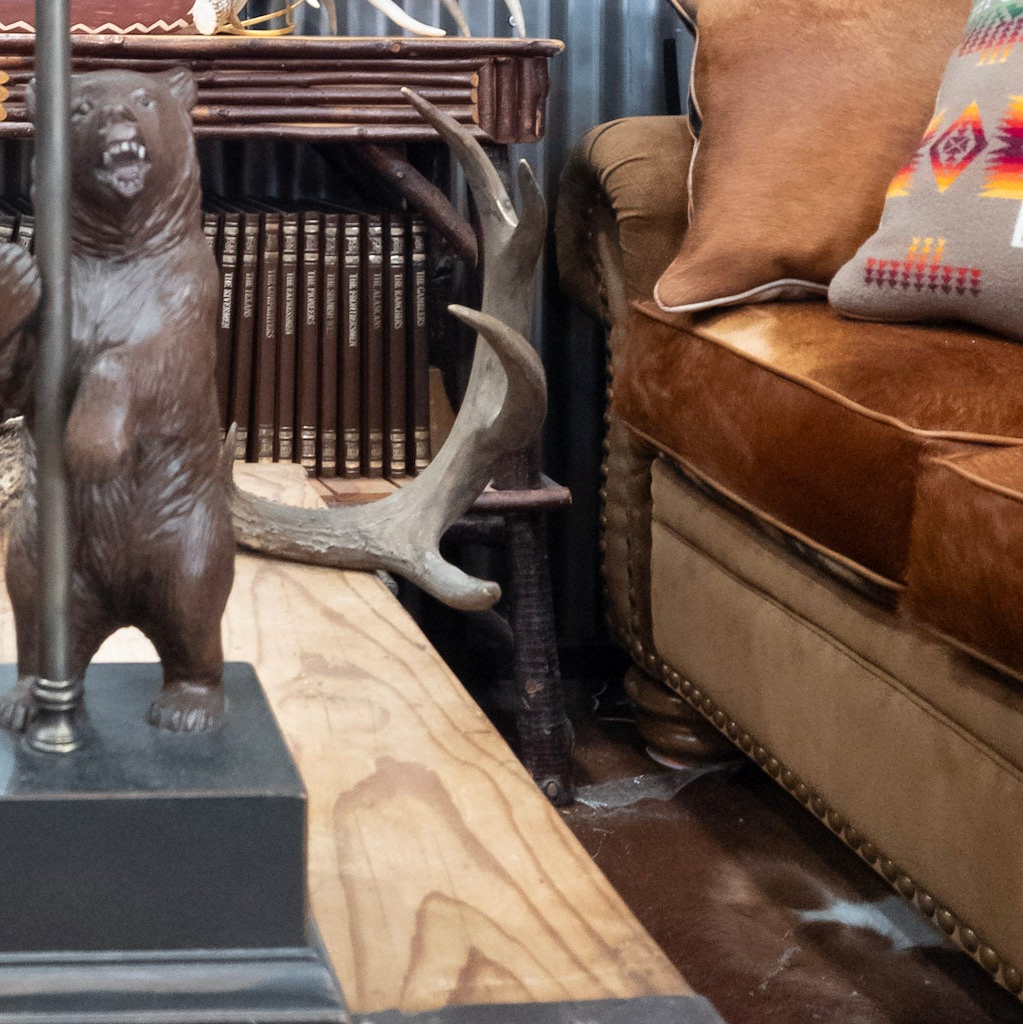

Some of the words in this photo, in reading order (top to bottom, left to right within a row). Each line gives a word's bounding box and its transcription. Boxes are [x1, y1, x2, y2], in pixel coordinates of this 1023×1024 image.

[224, 272, 233, 287] THE
[245, 272, 254, 287] THE
[267, 269, 276, 285] THE
[286, 272, 295, 287] THE
[307, 270, 316, 287] THE
[327, 273, 336, 288] THE
[348, 273, 358, 290] THE
[373, 273, 382, 288] THE
[394, 273, 403, 289] THE
[416, 270, 425, 286] THE
[244, 289, 253, 318] TEXANS
